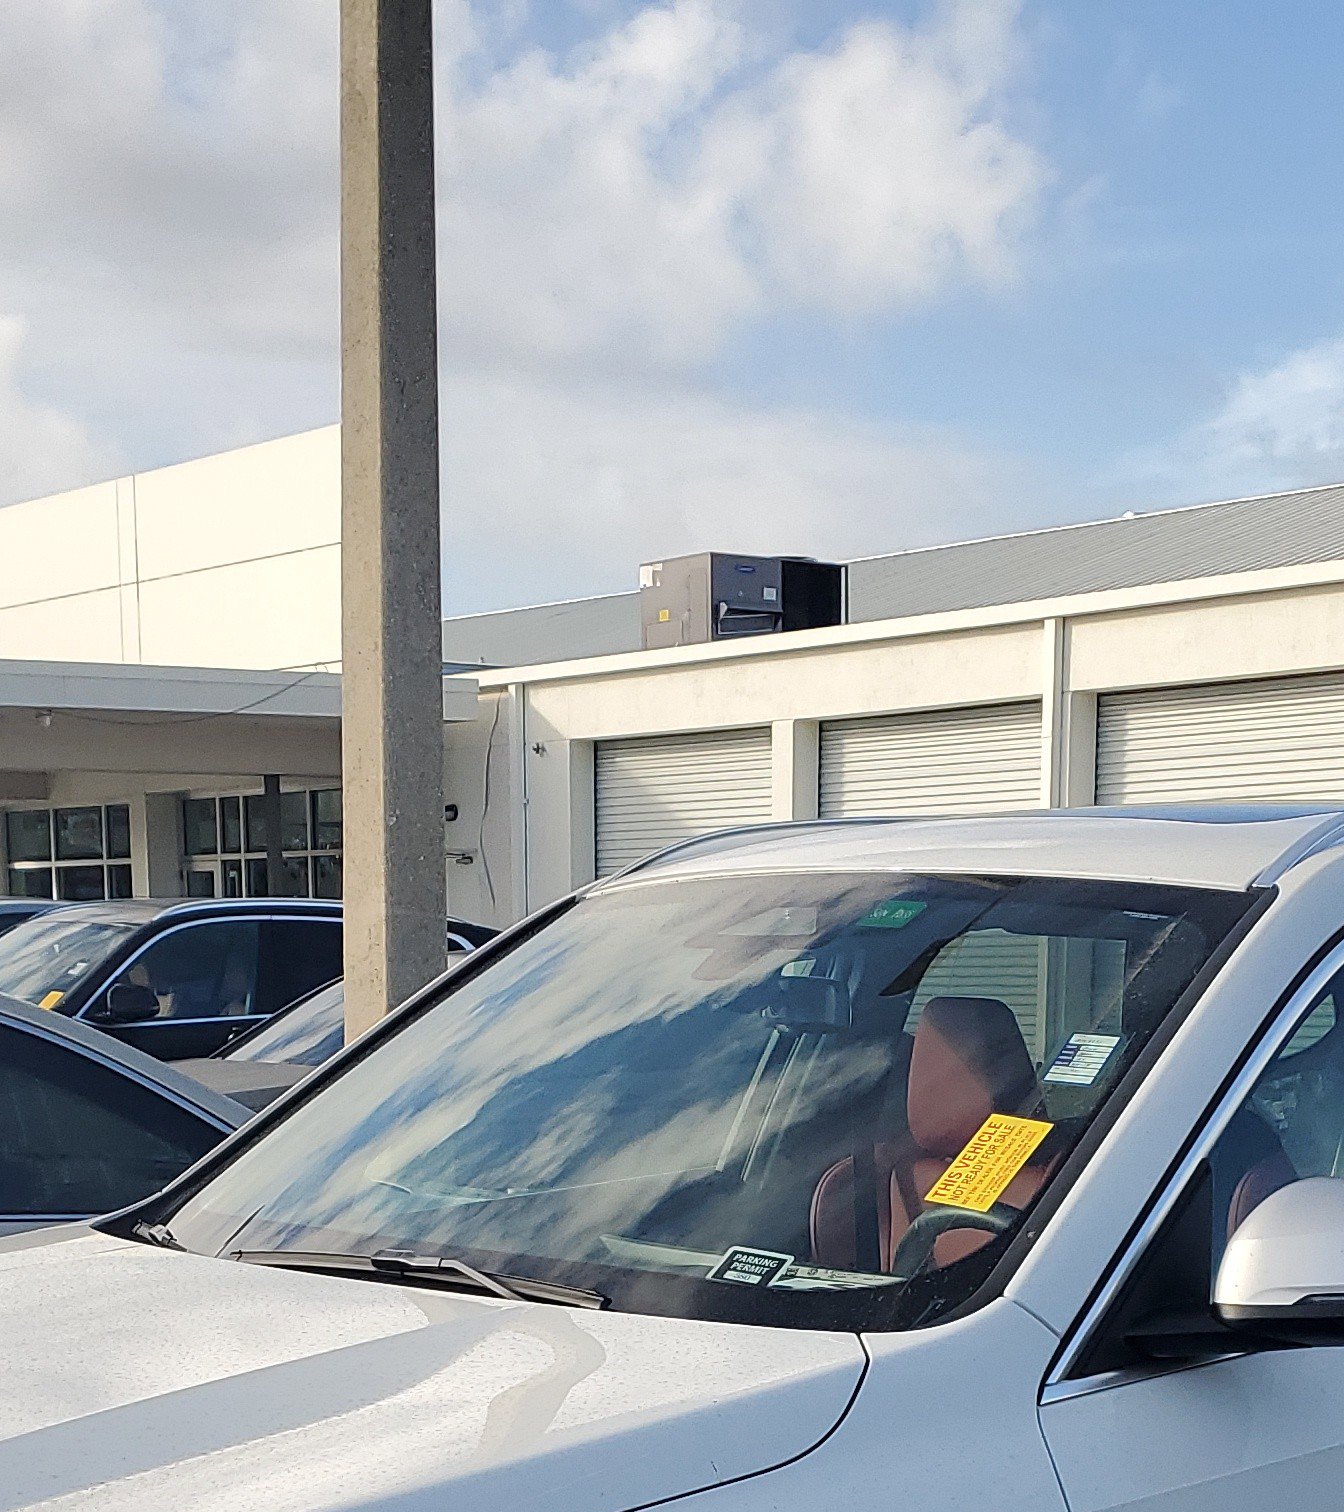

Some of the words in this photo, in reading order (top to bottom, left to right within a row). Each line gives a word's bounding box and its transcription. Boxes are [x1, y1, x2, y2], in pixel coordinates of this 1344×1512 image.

[933, 1171, 963, 1199] THIS
[955, 1121, 1004, 1169] VEHICLE
[947, 1184, 968, 1200] NOT
[960, 1159, 988, 1184] READY
[979, 1143, 1000, 1159] FOR
[992, 1124, 1016, 1143] SALE
[729, 1262, 771, 1274] PERMIT
[732, 1254, 778, 1268] PARKING
